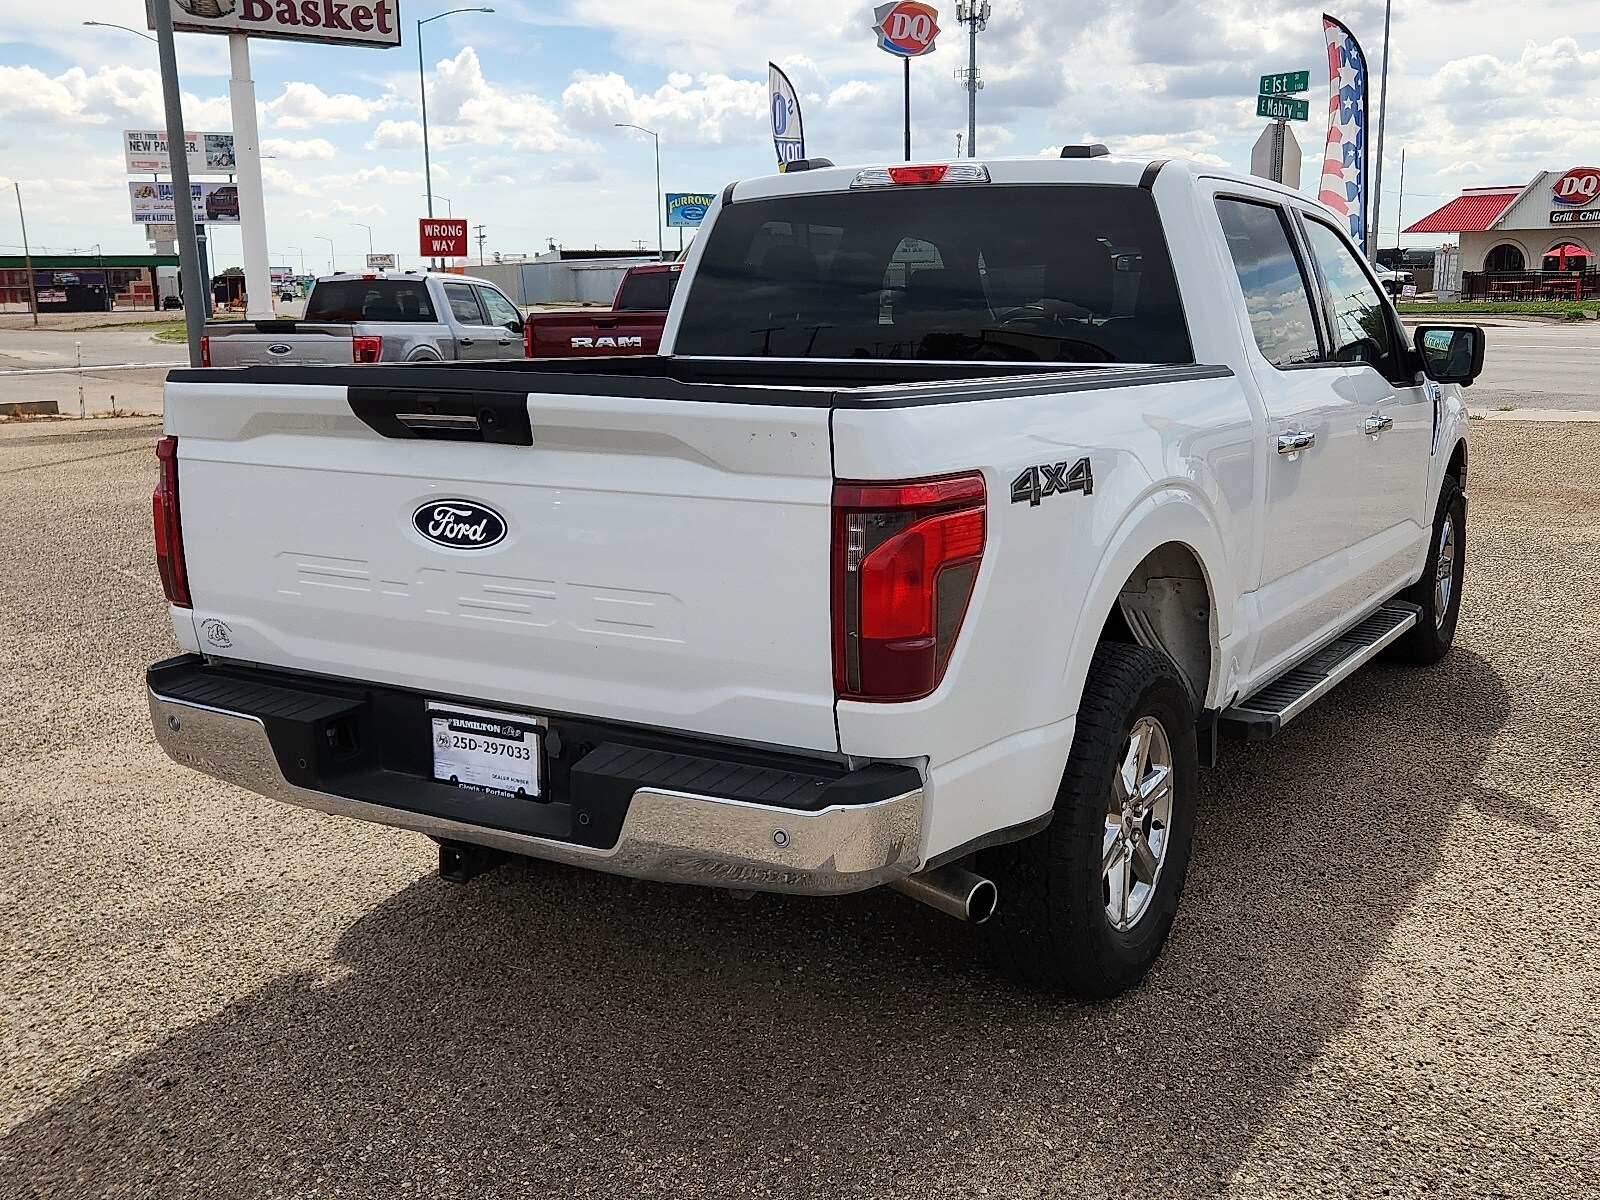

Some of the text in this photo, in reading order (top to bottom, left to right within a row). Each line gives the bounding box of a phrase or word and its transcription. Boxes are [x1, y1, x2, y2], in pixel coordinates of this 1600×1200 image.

[239, 0, 392, 34] Basket
[891, 14, 930, 45] DQ
[1264, 80, 1269, 91] E
[1272, 76, 1288, 92] 1st
[1261, 100, 1265, 111] E
[1267, 99, 1293, 118] Mabry
[129, 141, 151, 152] NEW
[1560, 175, 1597, 197] DQ
[1552, 212, 1573, 222] Grill
[424, 225, 462, 237] WRONG
[432, 240, 455, 252] WAY
[571, 337, 642, 348] RAM
[428, 506, 487, 541] Ford
[452, 718, 501, 734] HAMILTON
[452, 735, 530, 761] 25D-297033
[492, 773, 511, 782] DEALER
[485, 787, 515, 799] Portales
